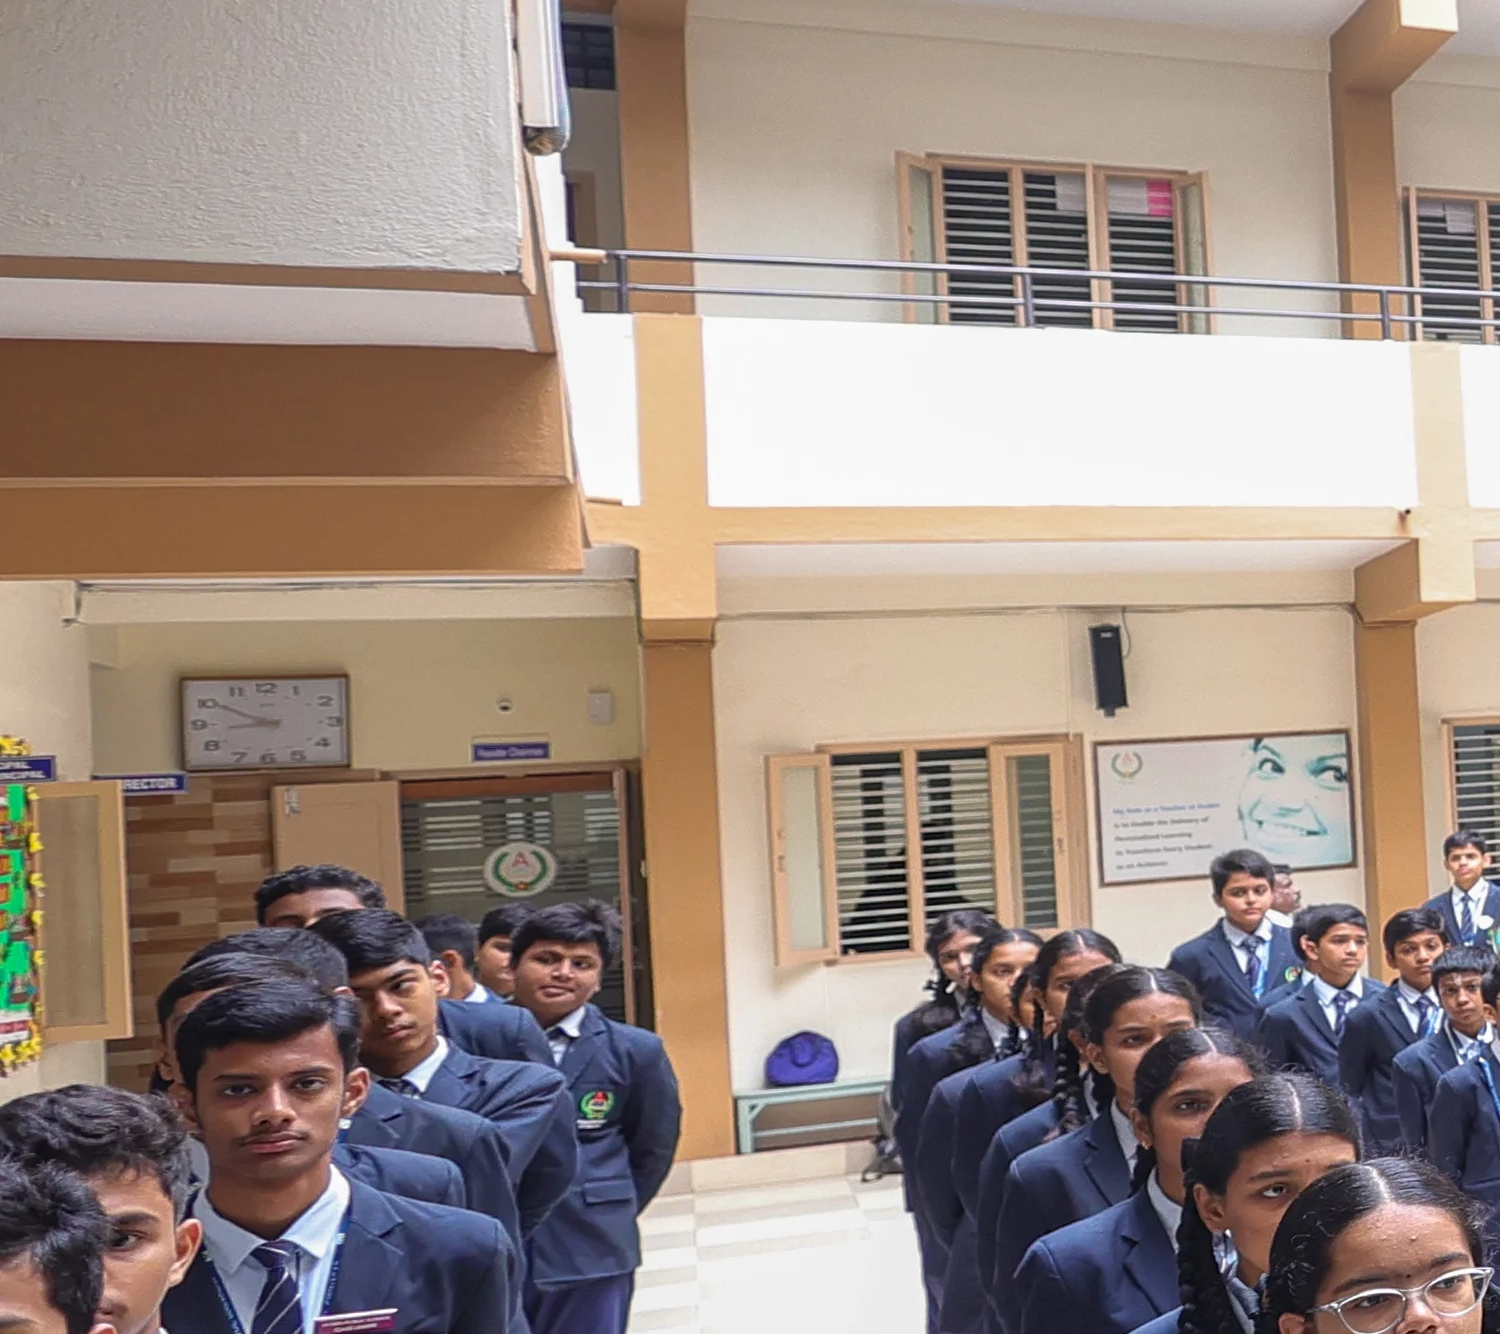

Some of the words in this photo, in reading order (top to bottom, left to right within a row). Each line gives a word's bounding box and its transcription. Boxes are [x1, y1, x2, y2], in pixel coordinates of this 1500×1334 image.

[229, 686, 245, 698] 11
[255, 682, 278, 694] 12
[197, 698, 219, 709] 10
[317, 695, 334, 708] 2
[190, 719, 208, 731] 9
[204, 739, 220, 752] 8
[314, 737, 331, 747] 4
[230, 751, 247, 763] 7
[259, 753, 277, 764] 6
[290, 750, 306, 762] 5
[124, 777, 178, 790] RECTOR
